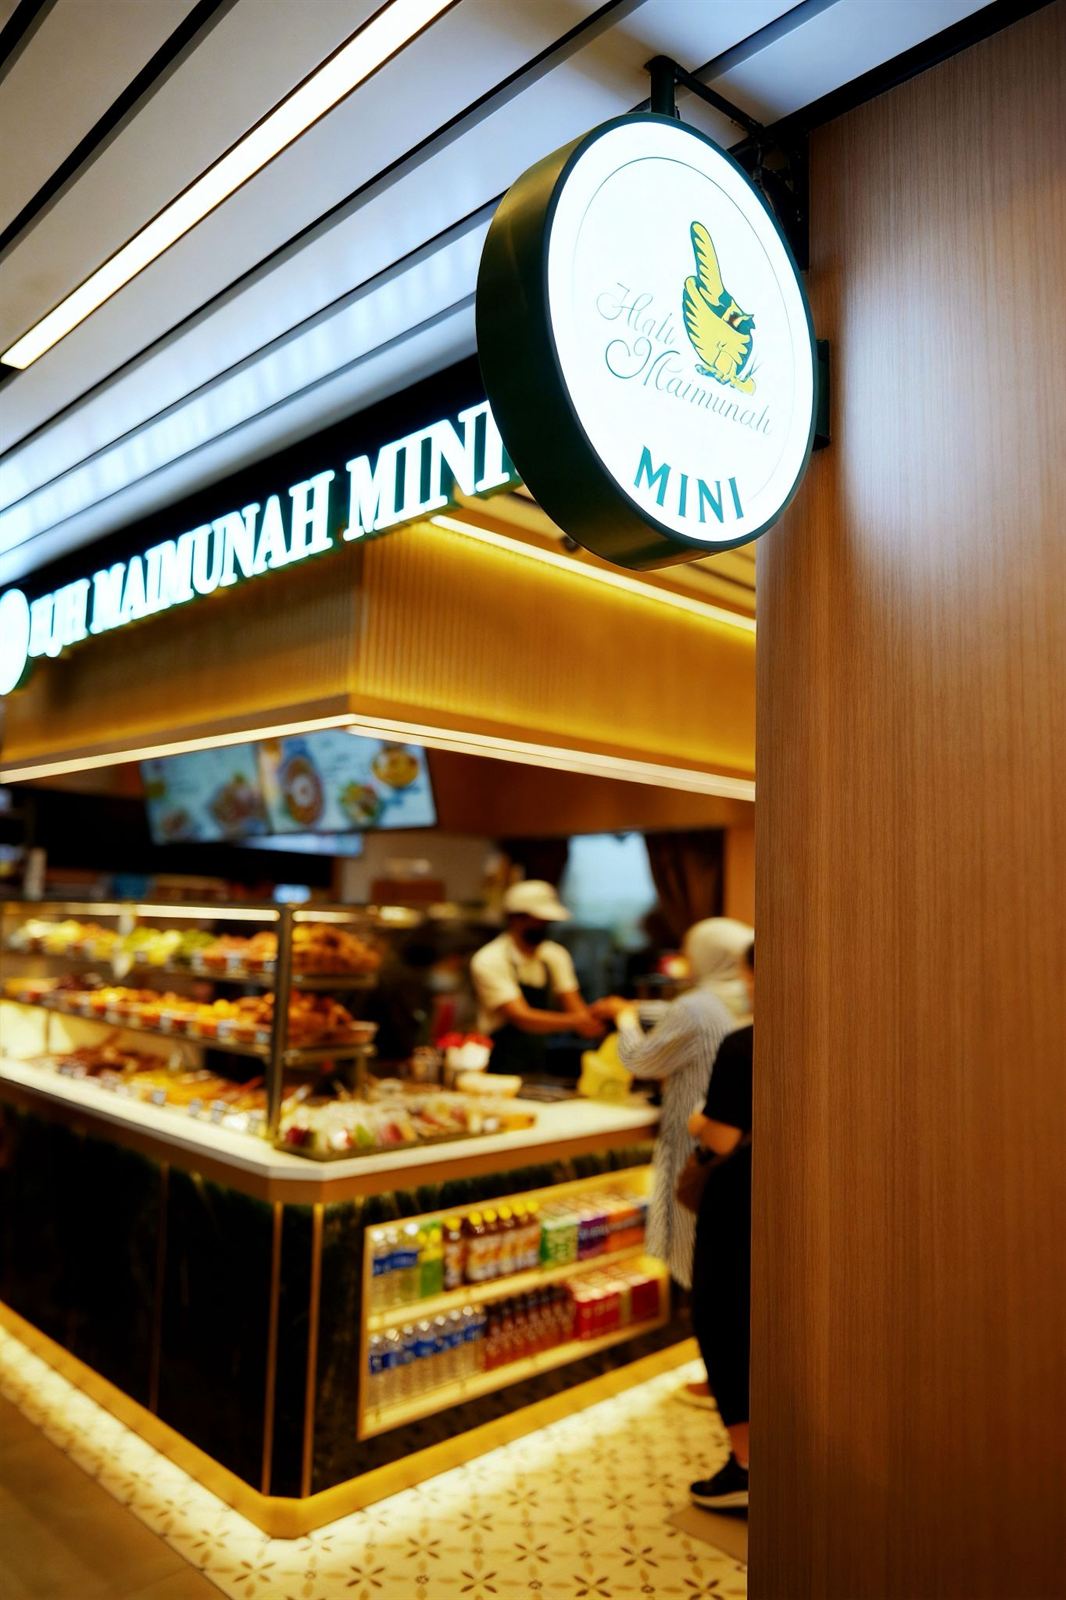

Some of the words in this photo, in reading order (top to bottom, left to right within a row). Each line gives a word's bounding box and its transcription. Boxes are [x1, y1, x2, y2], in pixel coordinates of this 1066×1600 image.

[605, 338, 771, 436] Maimunah
[89, 470, 335, 635] MAIMUNAH
[343, 399, 510, 542] MINI
[633, 445, 744, 524] MINI
